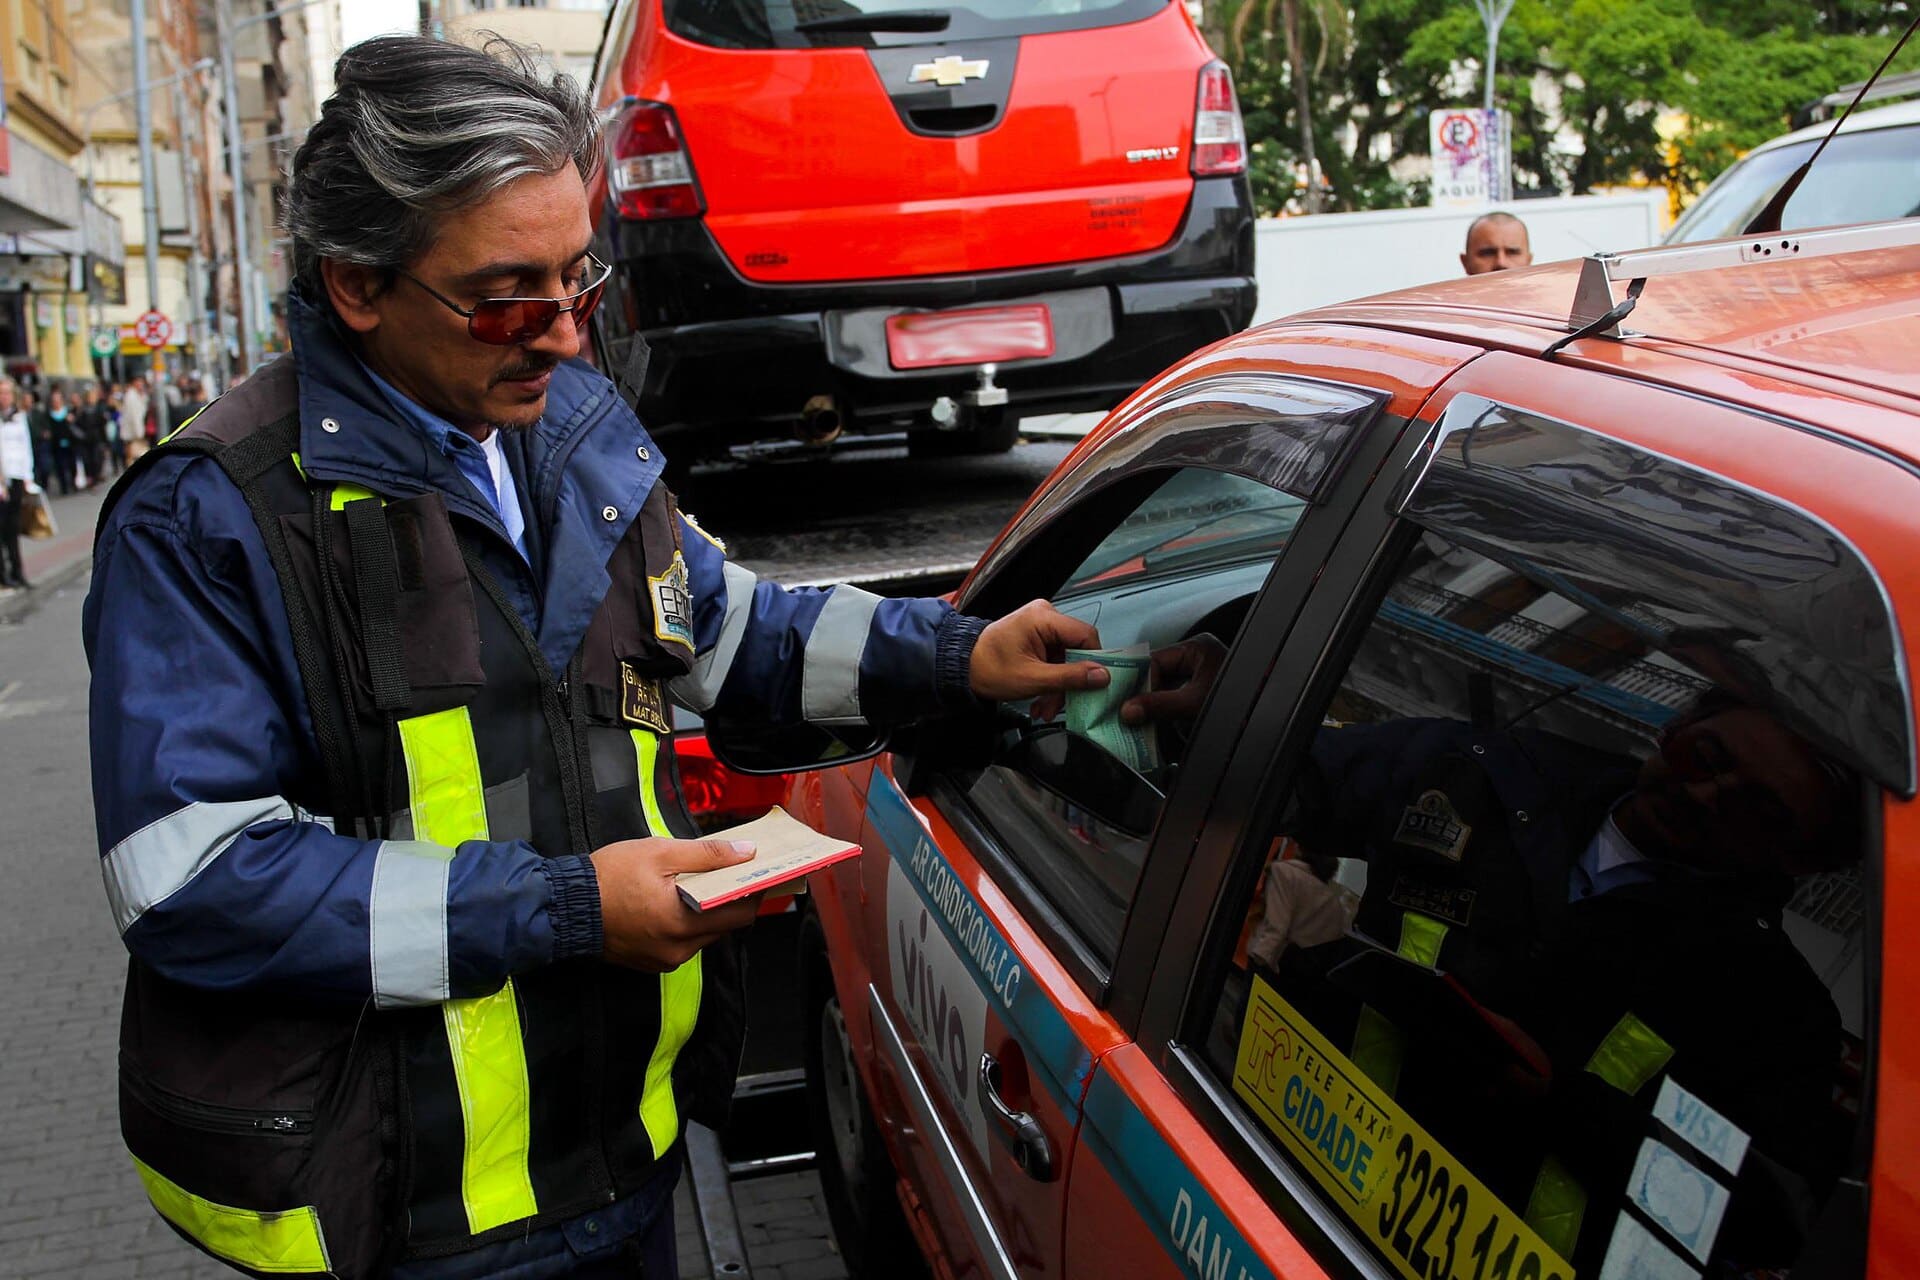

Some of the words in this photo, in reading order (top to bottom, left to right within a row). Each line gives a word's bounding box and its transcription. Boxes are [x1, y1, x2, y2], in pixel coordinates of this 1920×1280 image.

[911, 835, 930, 882] AR
[899, 908, 969, 1100] vivo
[1283, 1074, 1373, 1193] CIDADE
[1294, 1046, 1334, 1093] TELE
[1344, 1093, 1387, 1143] TÁXI
[1675, 1089, 1732, 1160] VISA
